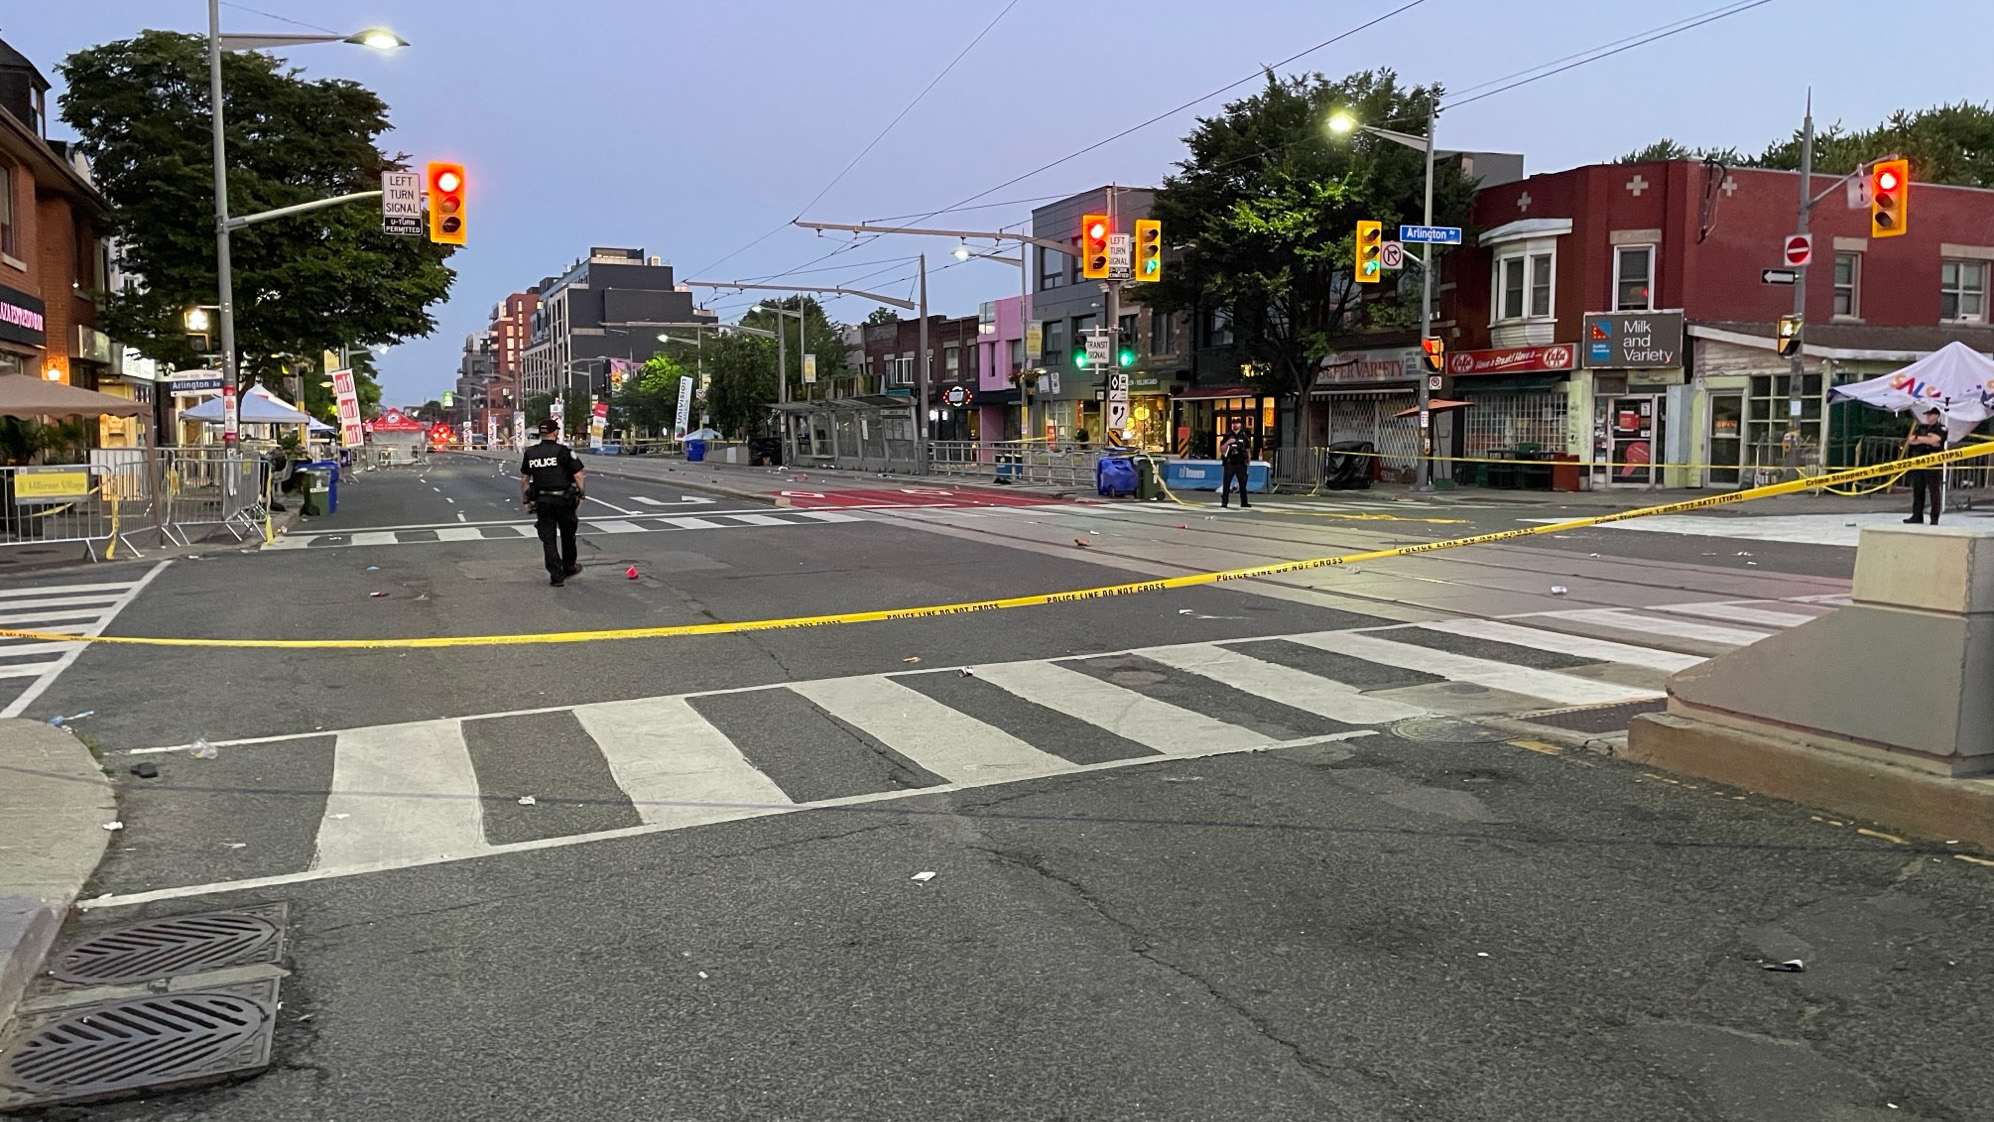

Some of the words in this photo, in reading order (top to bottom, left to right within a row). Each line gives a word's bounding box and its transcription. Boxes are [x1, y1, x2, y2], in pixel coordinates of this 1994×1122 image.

[389, 175, 413, 186] LEFT
[389, 189, 414, 200] TURN
[386, 202, 419, 214] SIGNAL
[386, 225, 421, 233] PERMITTED
[1406, 227, 1447, 242] Arlington
[1110, 236, 1125, 245] LEFT
[1110, 246, 1126, 255] TURN
[1623, 320, 1652, 334] Milk
[1087, 341, 1108, 349] TRANSIT
[1623, 334, 1651, 348] and
[1088, 351, 1106, 359] SIGNAL
[1623, 348, 1673, 364] Variety
[1355, 360, 1405, 378] VARIETY
[172, 381, 210, 390] Arlington
[1716, 420, 1738, 429] OPEN
[529, 457, 558, 469] POLICE
[1805, 476, 1830, 487] Crime
[1832, 470, 1869, 483] Stoppers
[1938, 450, 1963, 463] (TIPS)
[1719, 493, 1743, 504] (TIPS)
[1313, 557, 1343, 568] CROSS
[1047, 594, 1076, 604] POLICE
[1080, 591, 1099, 600] LINE
[1102, 589, 1114, 597] DO
[1117, 586, 1133, 595] NOT
[1137, 582, 1166, 593] CROSS
[887, 612, 915, 620] POLICE
[972, 603, 1000, 611] CROSS
